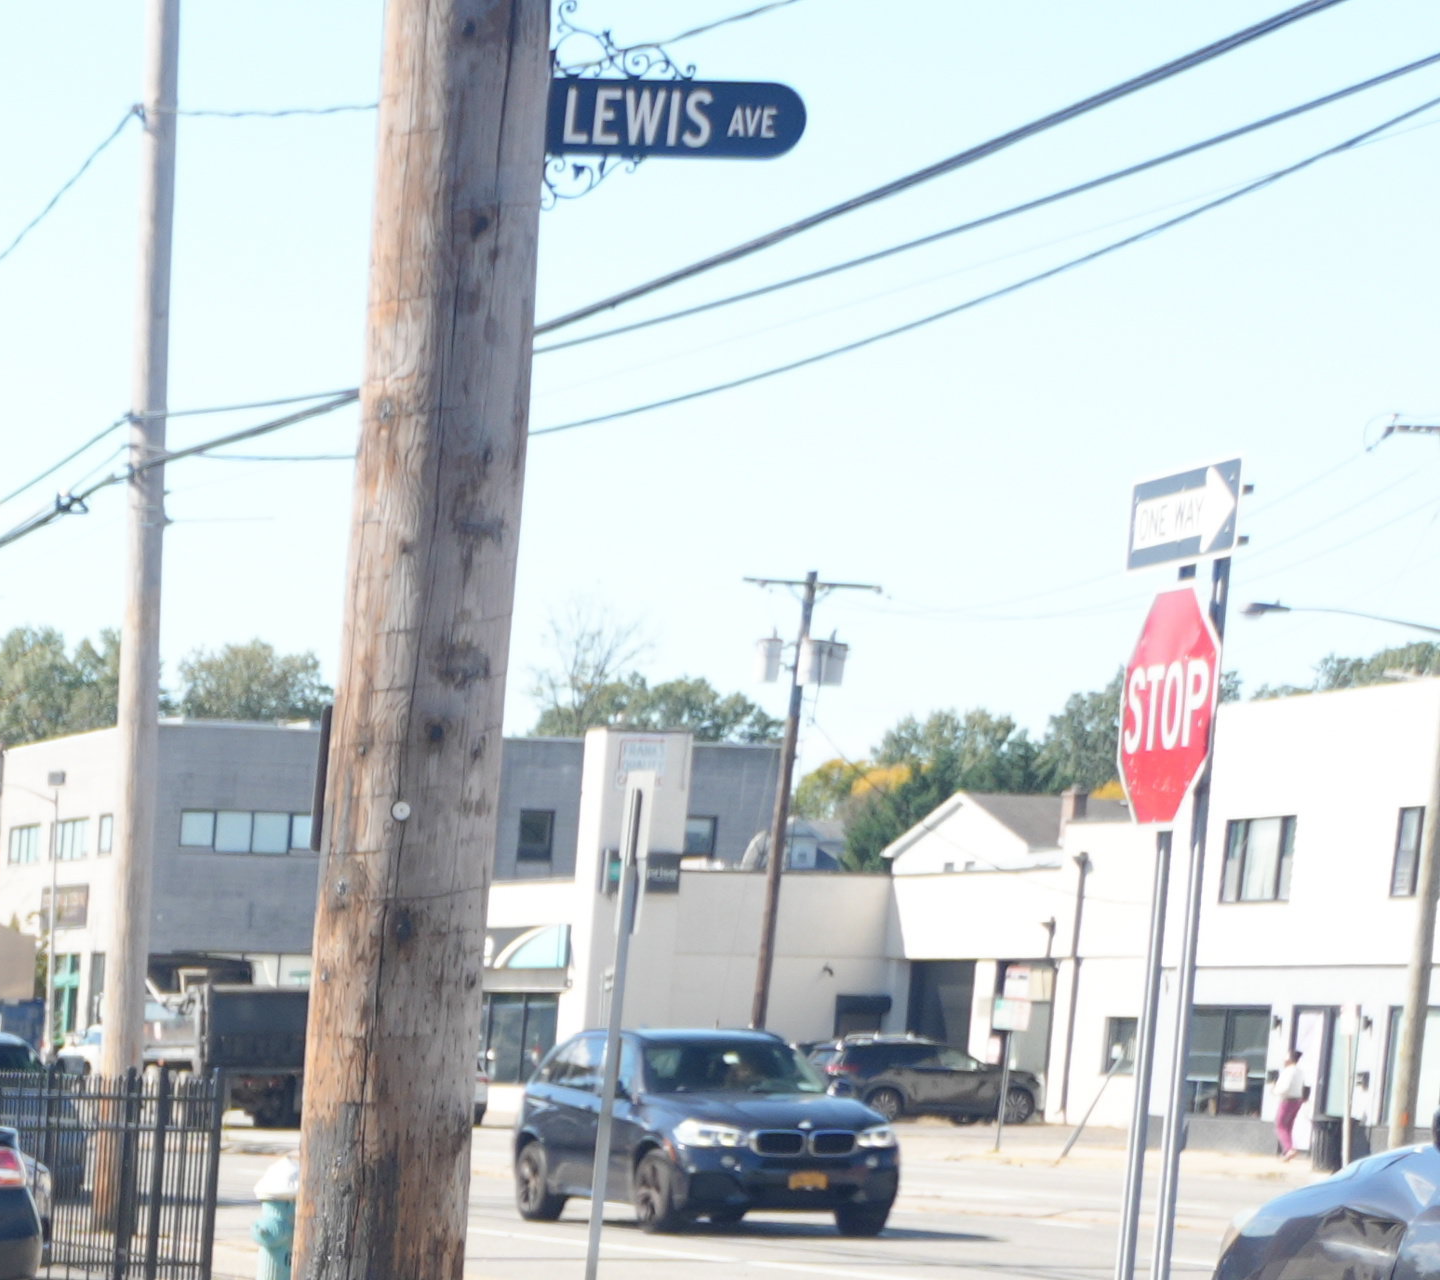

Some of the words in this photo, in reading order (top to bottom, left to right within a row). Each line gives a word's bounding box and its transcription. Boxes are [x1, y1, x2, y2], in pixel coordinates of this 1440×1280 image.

[562, 86, 714, 149] LEWIS
[726, 104, 778, 139] AVE
[1138, 503, 1169, 542] ONE
[1174, 495, 1206, 532] WAY
[1123, 658, 1210, 755] STOP
